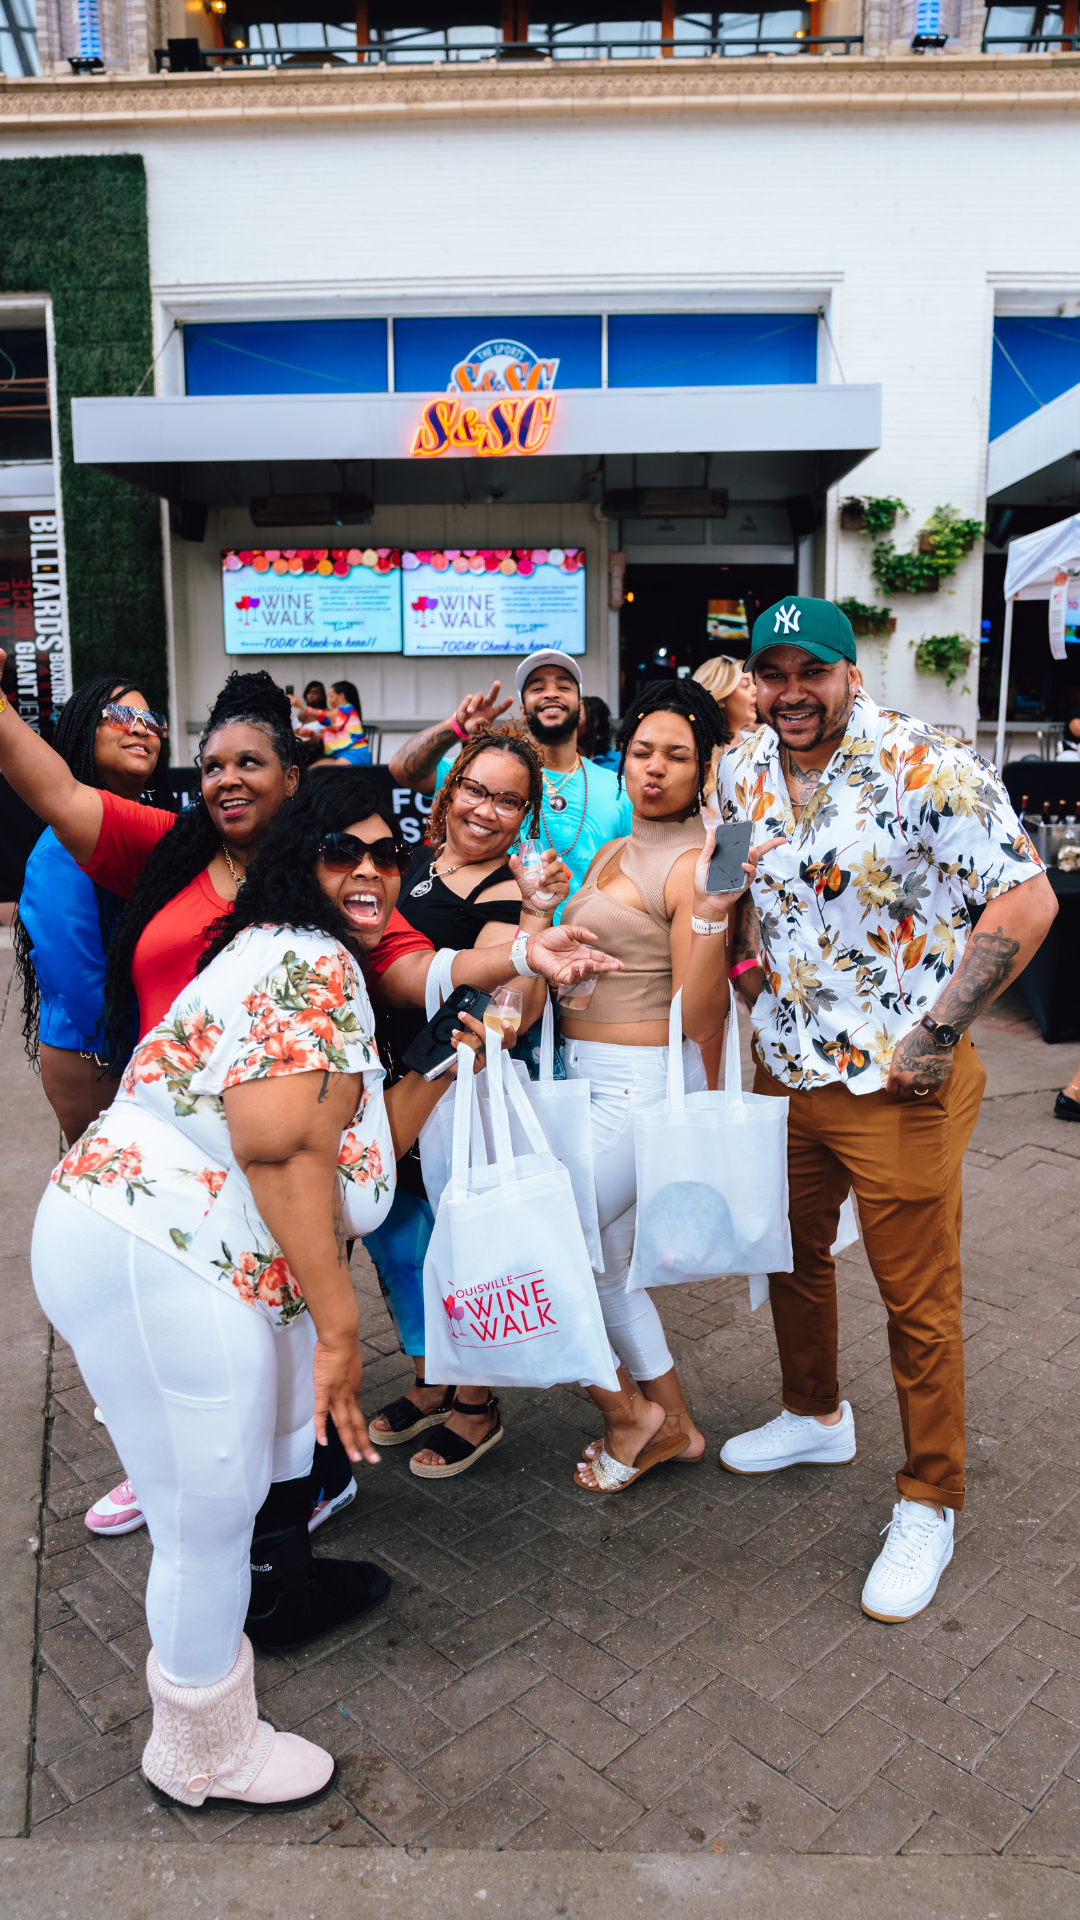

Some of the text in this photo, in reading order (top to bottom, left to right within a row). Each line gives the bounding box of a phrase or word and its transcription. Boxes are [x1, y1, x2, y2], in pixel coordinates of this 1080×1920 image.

[476, 346, 493, 361] THE
[410, 394, 557, 455] S&SC
[29, 515, 64, 651] BILLIARDS
[12, 578, 34, 638] BOCCE
[262, 594, 313, 609] WINE
[440, 594, 494, 610] WINE
[262, 610, 315, 626] WALK
[439, 612, 496, 628] WALK
[773, 603, 802, 635] NY
[264, 637, 300, 649] TODAY
[300, 636, 343, 648] Check-in
[441, 641, 479, 652] TODAY
[480, 640, 525, 651] Check-in
[15, 641, 38, 698] GIANT
[49, 652, 66, 704] BOXING
[454, 1275, 514, 1299] OUISVILLE
[464, 1278, 550, 1320] WINE
[469, 1302, 557, 1342] WALK
